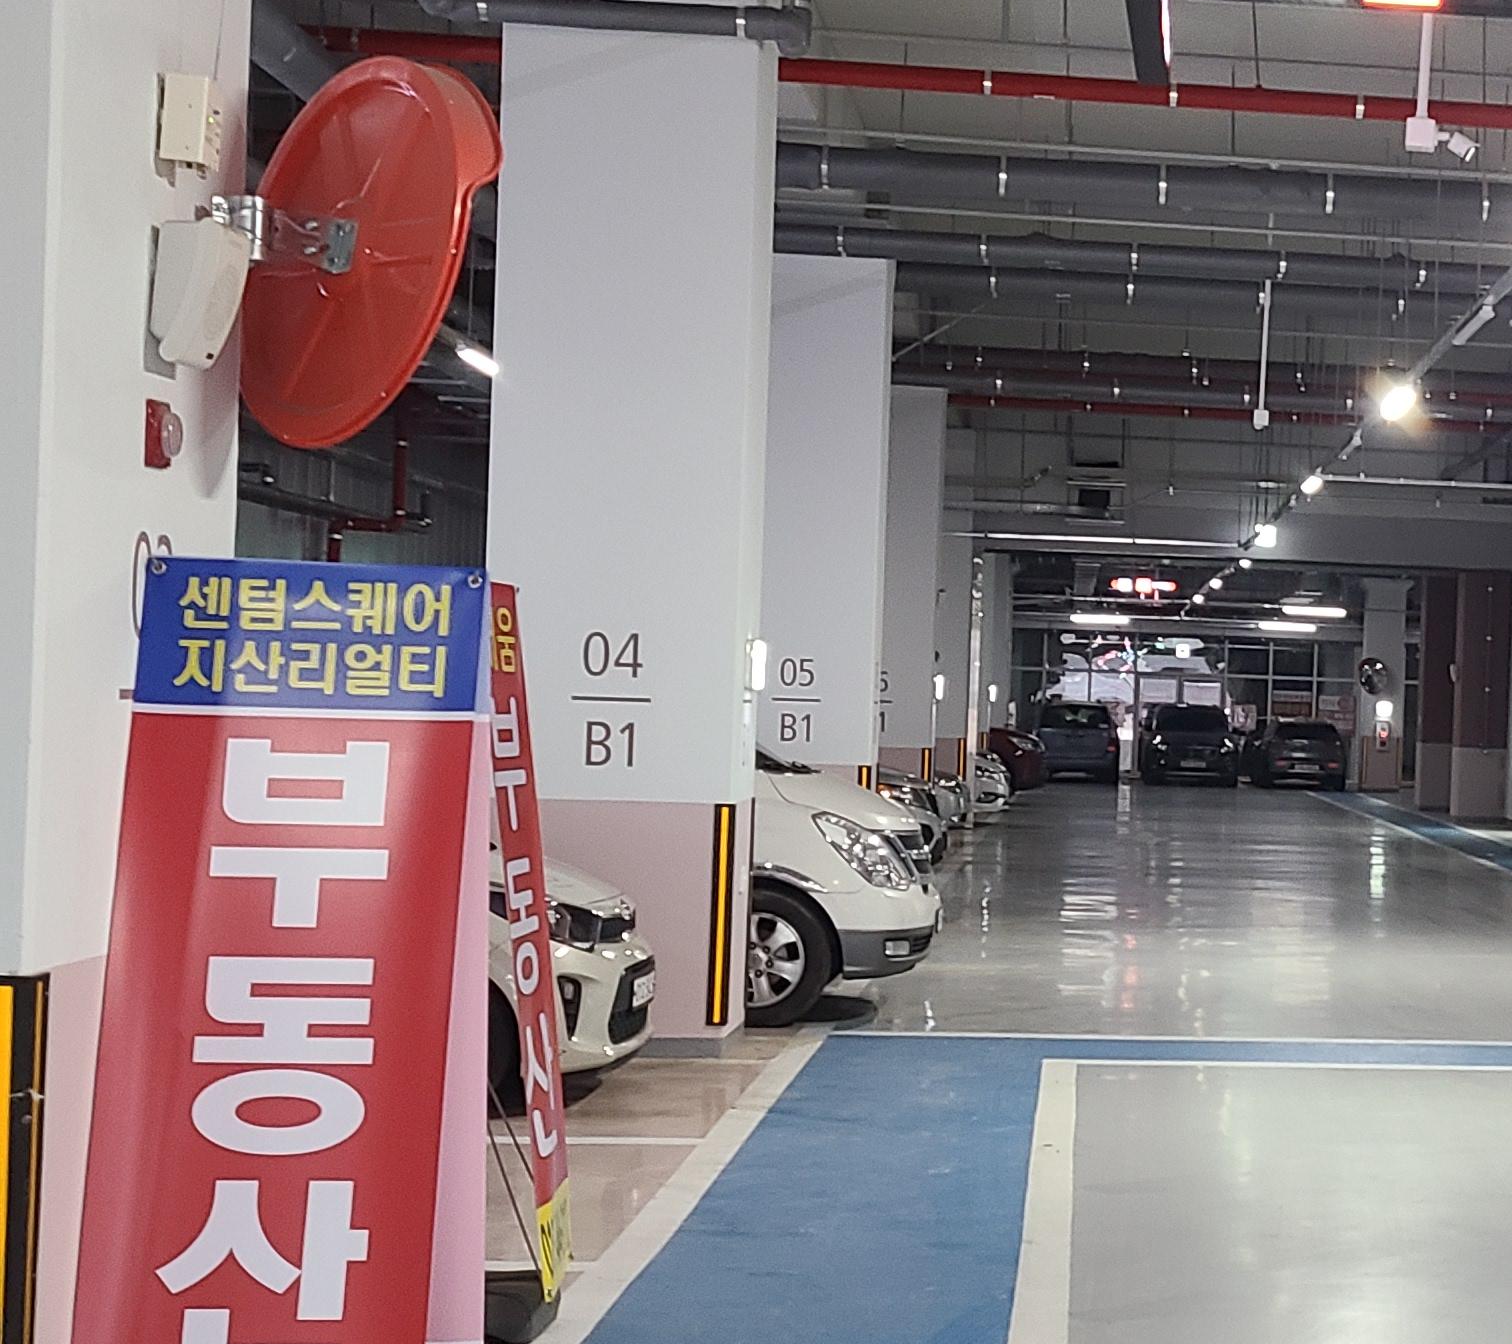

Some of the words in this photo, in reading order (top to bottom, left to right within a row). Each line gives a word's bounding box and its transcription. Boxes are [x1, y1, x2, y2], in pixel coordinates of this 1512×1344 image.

[178, 575, 453, 637] 센텀스퀘어
[172, 638, 448, 698] 지산리얼티
[583, 631, 644, 678] 04
[779, 658, 815, 687] 05
[585, 720, 635, 768] B1
[779, 713, 812, 743] B1
